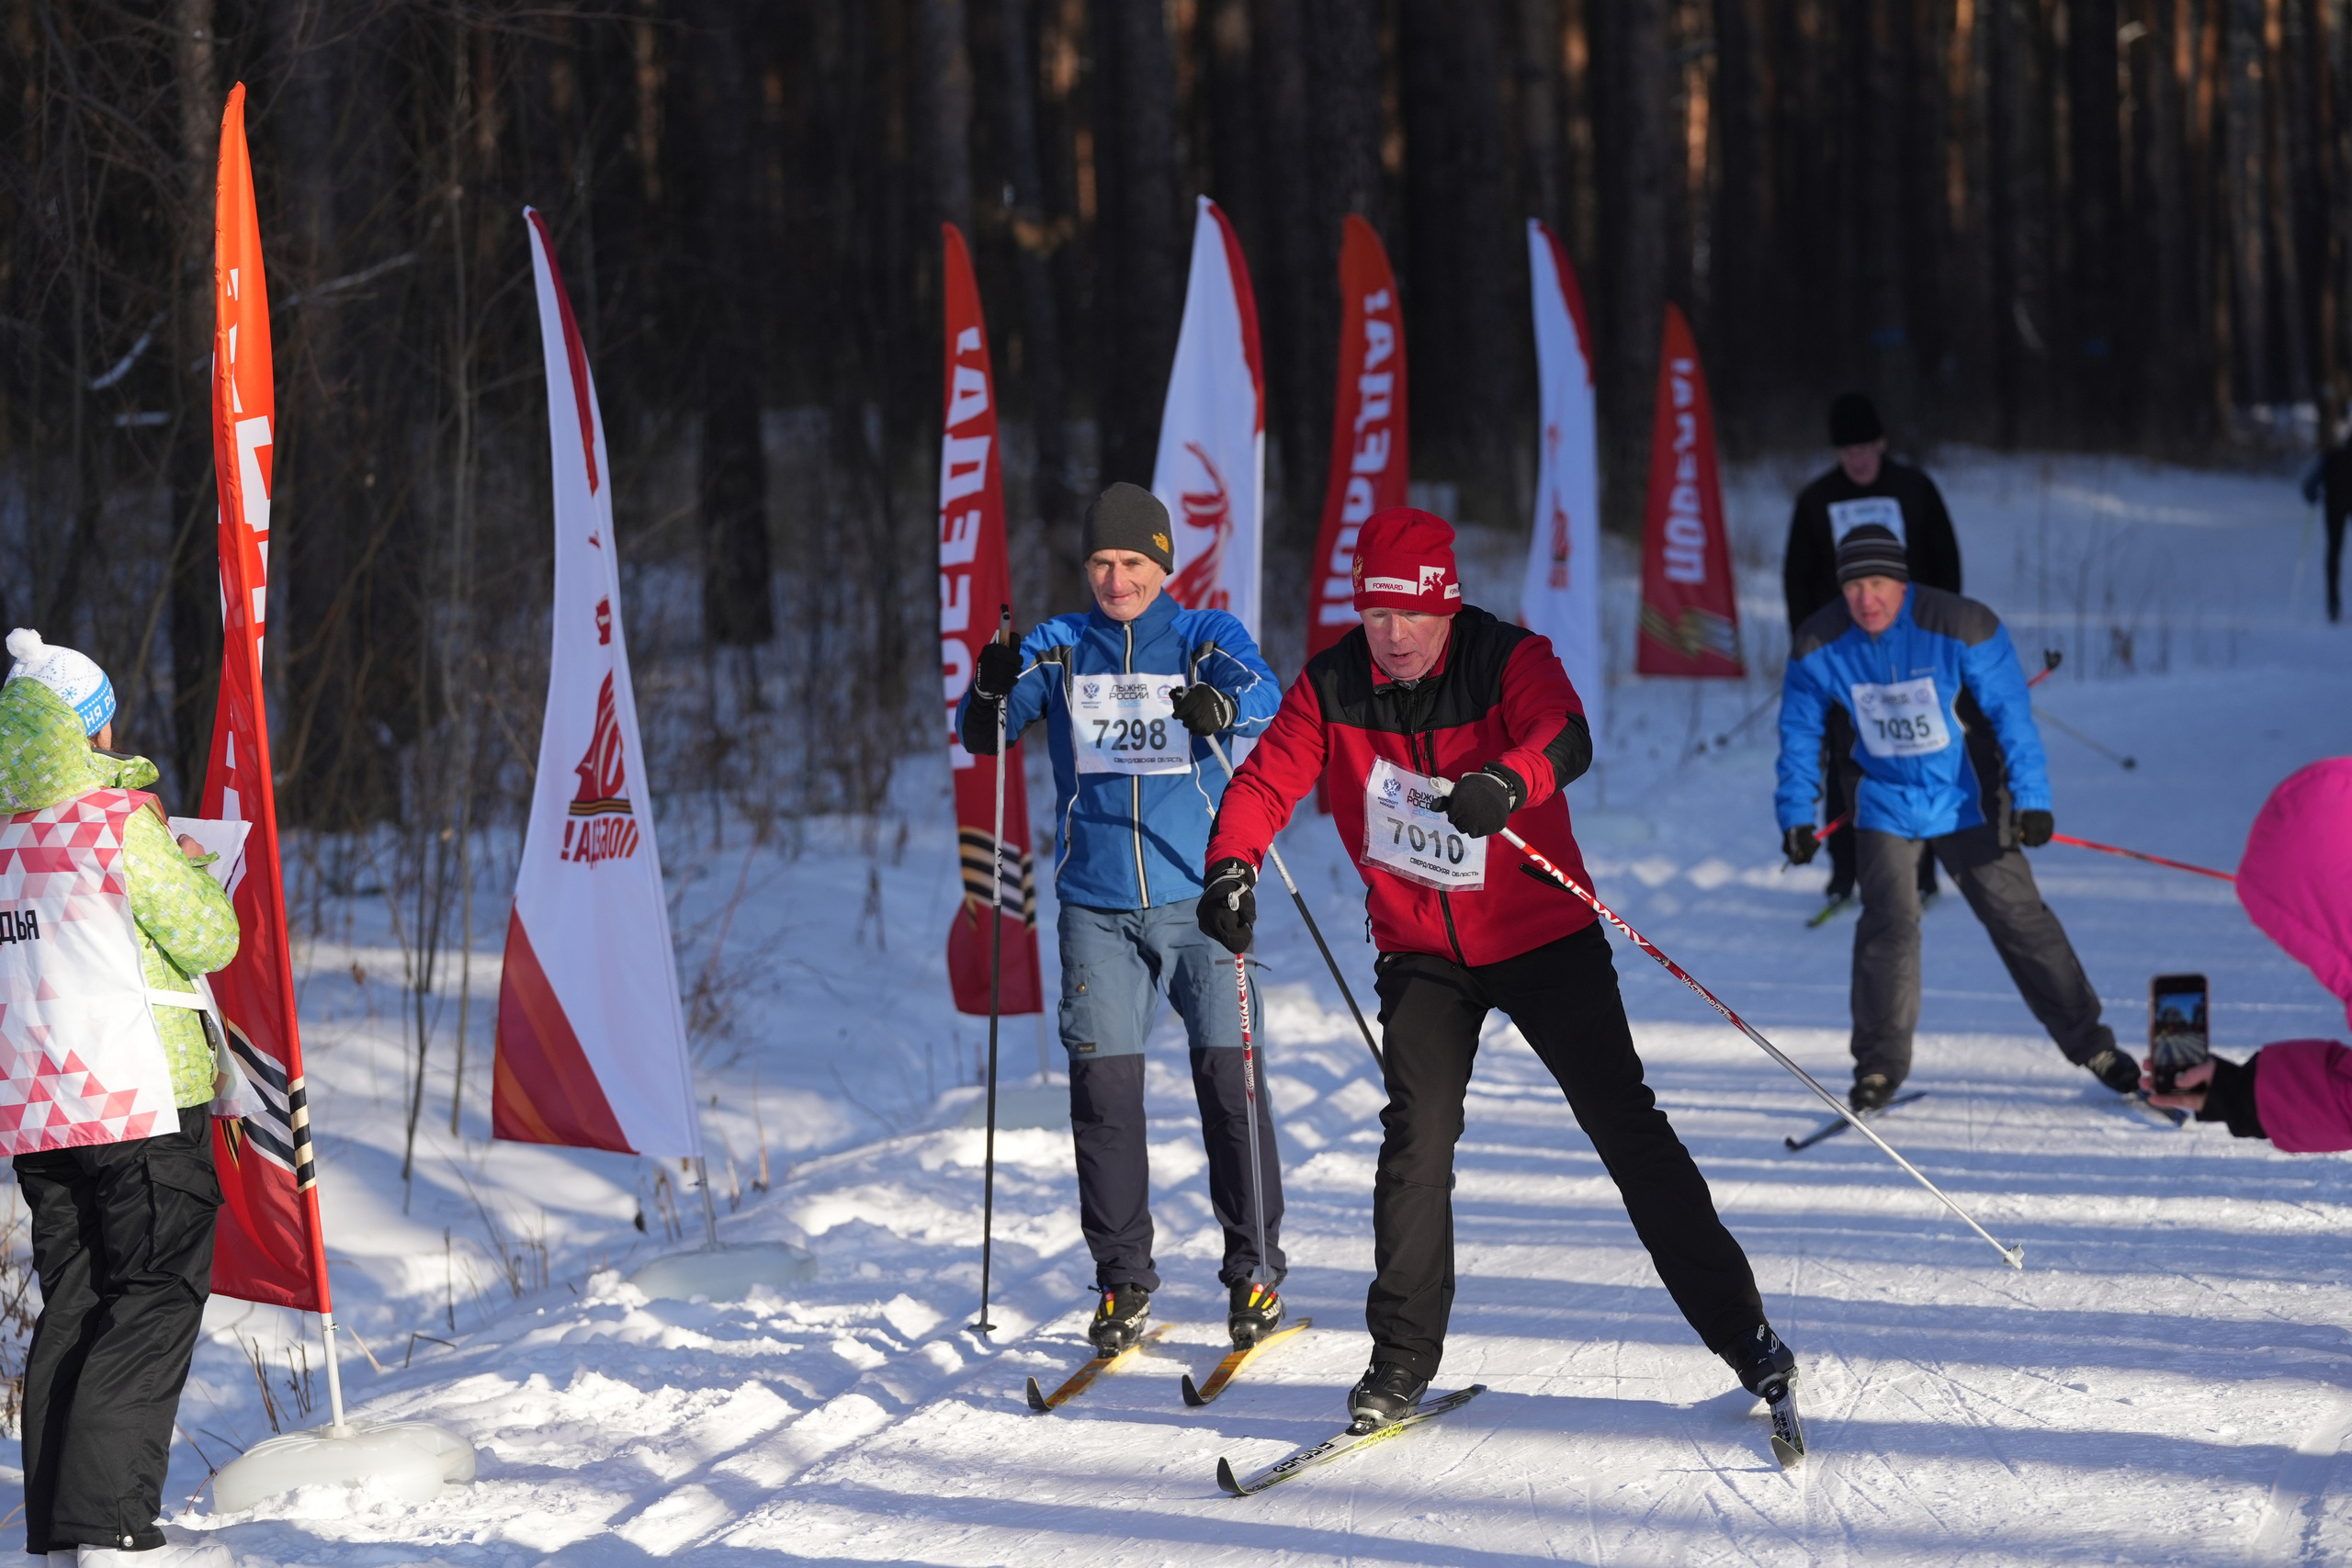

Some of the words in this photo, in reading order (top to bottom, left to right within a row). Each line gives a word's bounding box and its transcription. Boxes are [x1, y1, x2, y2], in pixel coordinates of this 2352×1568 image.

[1373, 582, 1403, 591] FORWARD
[1111, 683, 1148, 692] ЛЫЖНЯ
[1109, 692, 1149, 700] РОССИИ
[1092, 718, 1168, 750] 7298
[1872, 714, 1931, 741] 7035
[1411, 807, 1441, 820] 2025
[1386, 817, 1464, 864] 7010
[1409, 857, 1450, 875] СВЕРДЛОВСКАЯ
